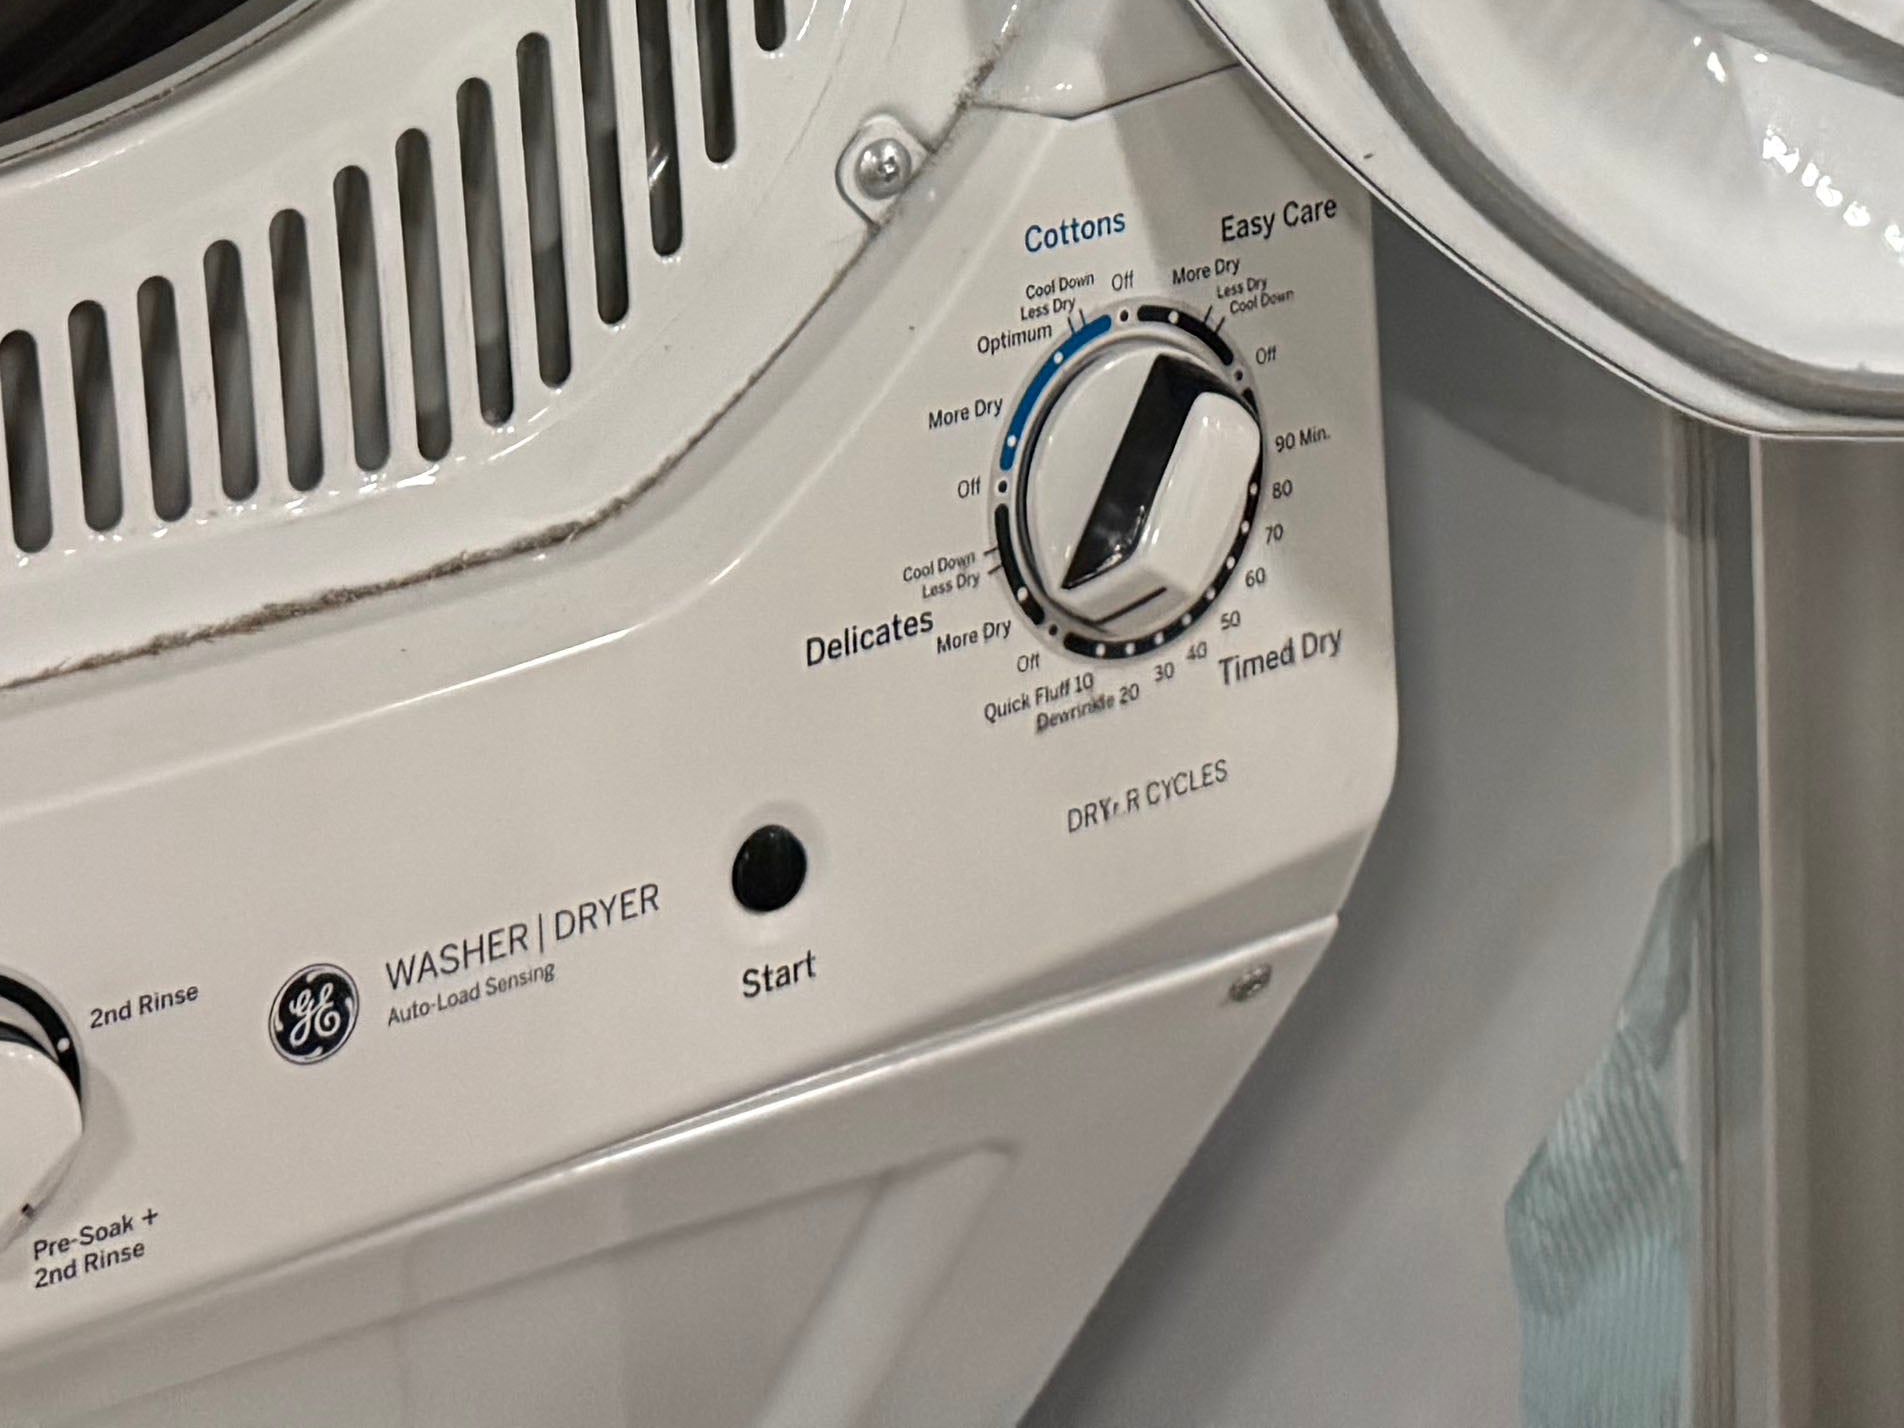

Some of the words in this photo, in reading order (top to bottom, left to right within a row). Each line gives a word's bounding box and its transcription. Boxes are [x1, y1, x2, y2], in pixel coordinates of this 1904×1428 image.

[1025, 212, 1126, 252] Cottons
[1221, 210, 1276, 245] Easy
[1282, 196, 1338, 228] Care
[1111, 271, 1134, 291] Off
[1172, 263, 1211, 285] More
[1212, 255, 1241, 281] Dry
[1026, 278, 1055, 299] Cool
[1058, 271, 1095, 294] Down
[1217, 281, 1241, 299] Less
[1242, 275, 1268, 295] Dry
[1020, 300, 1049, 320] Less
[1052, 295, 1076, 317] Dry
[1230, 294, 1257, 314] Cool
[977, 323, 1053, 355] Optimum
[1255, 345, 1277, 364] Off
[928, 404, 968, 429] More
[971, 396, 1003, 422] Dry
[1275, 433, 1295, 452] 90
[1299, 426, 1331, 446] Min.
[958, 477, 981, 498] Off
[1272, 479, 1292, 499] 80
[1264, 524, 1284, 543] 70
[902, 561, 933, 583] Cool
[936, 551, 976, 575] Down
[1245, 568, 1266, 589] 60
[922, 579, 952, 600] Less
[955, 571, 980, 595] Dry
[1221, 610, 1241, 630] 50
[805, 609, 935, 666] Delicates
[936, 630, 978, 655] More
[978, 619, 1012, 644] Dry
[1187, 642, 1208, 661] 40
[1017, 651, 1040, 673] Off
[1218, 644, 1294, 687] Timed
[1301, 628, 1342, 668] Dry
[1154, 663, 1175, 682] 30
[984, 692, 1031, 724] Quick
[1074, 673, 1094, 692] 10
[1119, 683, 1140, 703] 20
[1147, 759, 1229, 810] CYCLES
[385, 921, 527, 992] WASHER
[553, 883, 660, 944] DRYER
[741, 949, 817, 1001] Start
[89, 1000, 132, 1032] 2nd
[138, 982, 199, 1020] Rinse
[385, 979, 482, 1028] Auto-Load
[487, 960, 556, 996] Sensing
[31, 1211, 136, 1262] Pre-Soak
[33, 1254, 78, 1289] 2nd
[84, 1236, 146, 1276] Rinse
